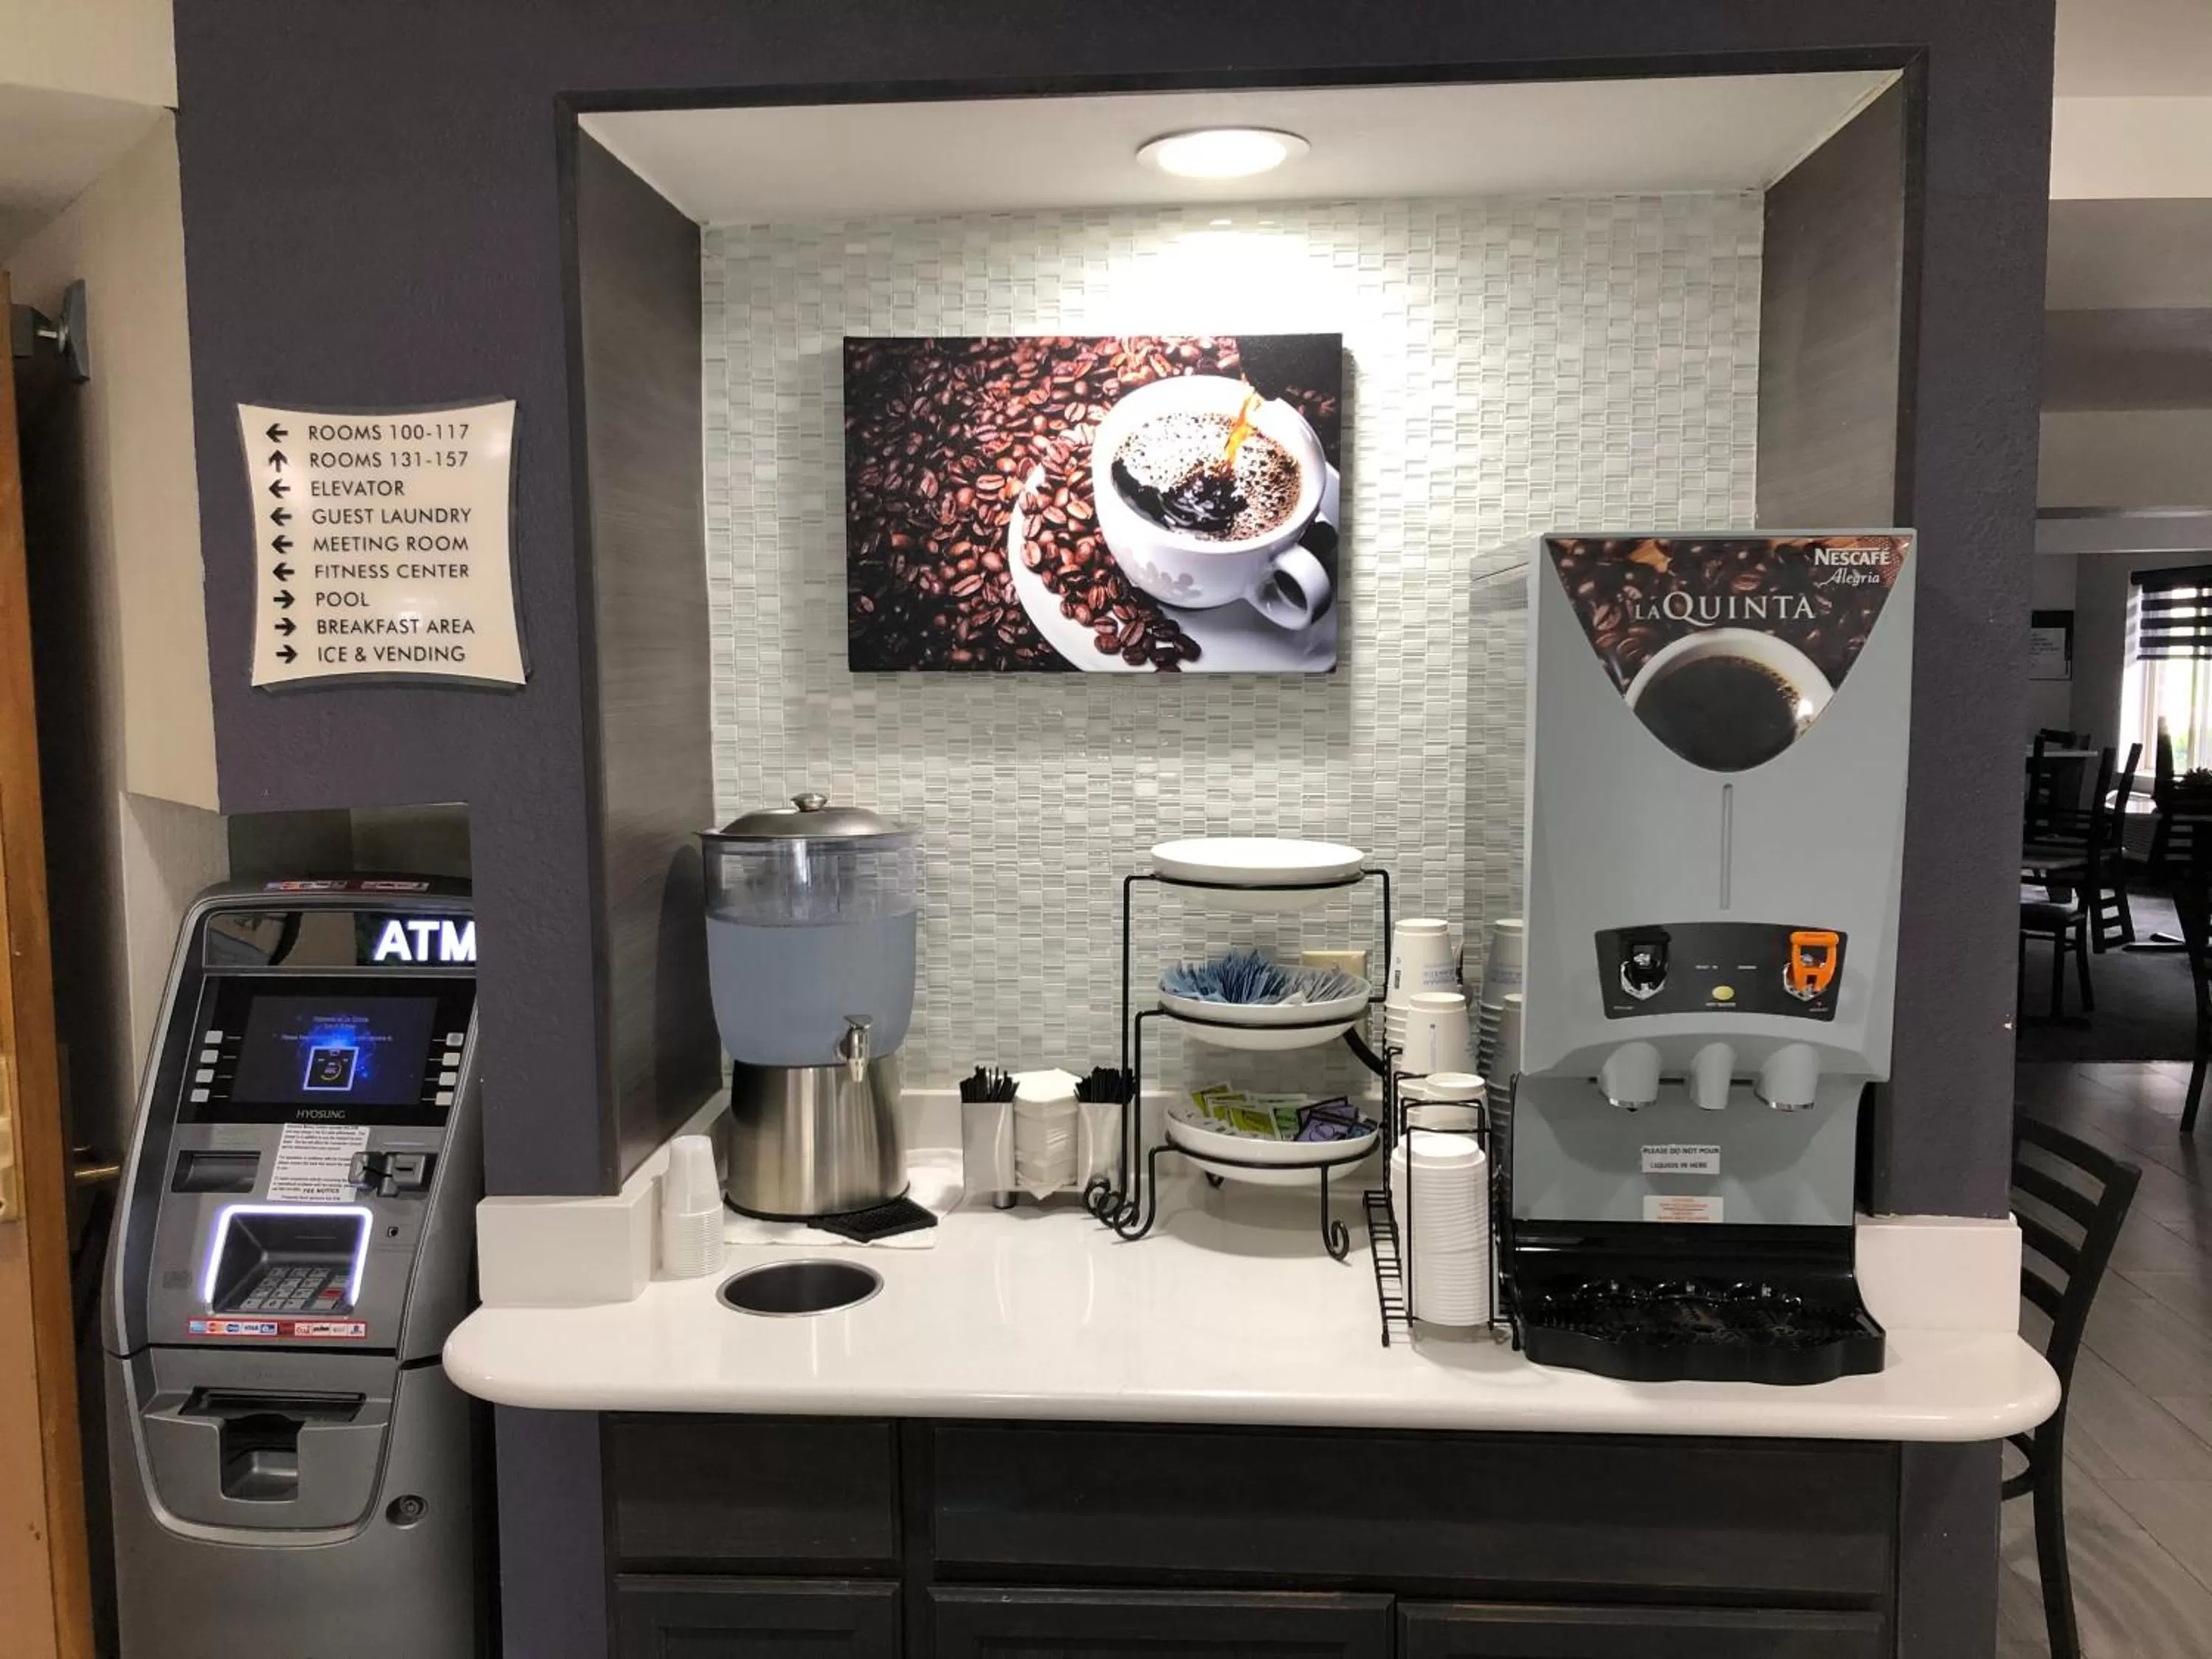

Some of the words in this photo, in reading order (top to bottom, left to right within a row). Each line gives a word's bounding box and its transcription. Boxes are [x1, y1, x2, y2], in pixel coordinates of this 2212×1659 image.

[308, 424, 382, 441] ROOMS
[391, 424, 469, 440] 100-117
[310, 452, 382, 468] ROOMS
[391, 451, 468, 467] 131-157
[311, 480, 405, 496] ELEVATOR
[312, 508, 374, 525] GUEST
[381, 507, 471, 524] LAUNDRY
[313, 535, 400, 552] MEETING
[406, 535, 468, 552] ROOM
[315, 564, 389, 579] FITNESS
[396, 563, 469, 579] CENTER
[316, 591, 369, 608] POOL
[1662, 591, 1816, 627] QUINTA
[316, 619, 420, 635] BREAKFAST
[426, 619, 475, 634] AREA
[318, 646, 347, 664] ICE
[355, 646, 366, 663] &
[372, 645, 465, 662] VENDING
[372, 919, 477, 961] ATM
[296, 1109, 346, 1119] HYOSUNG
